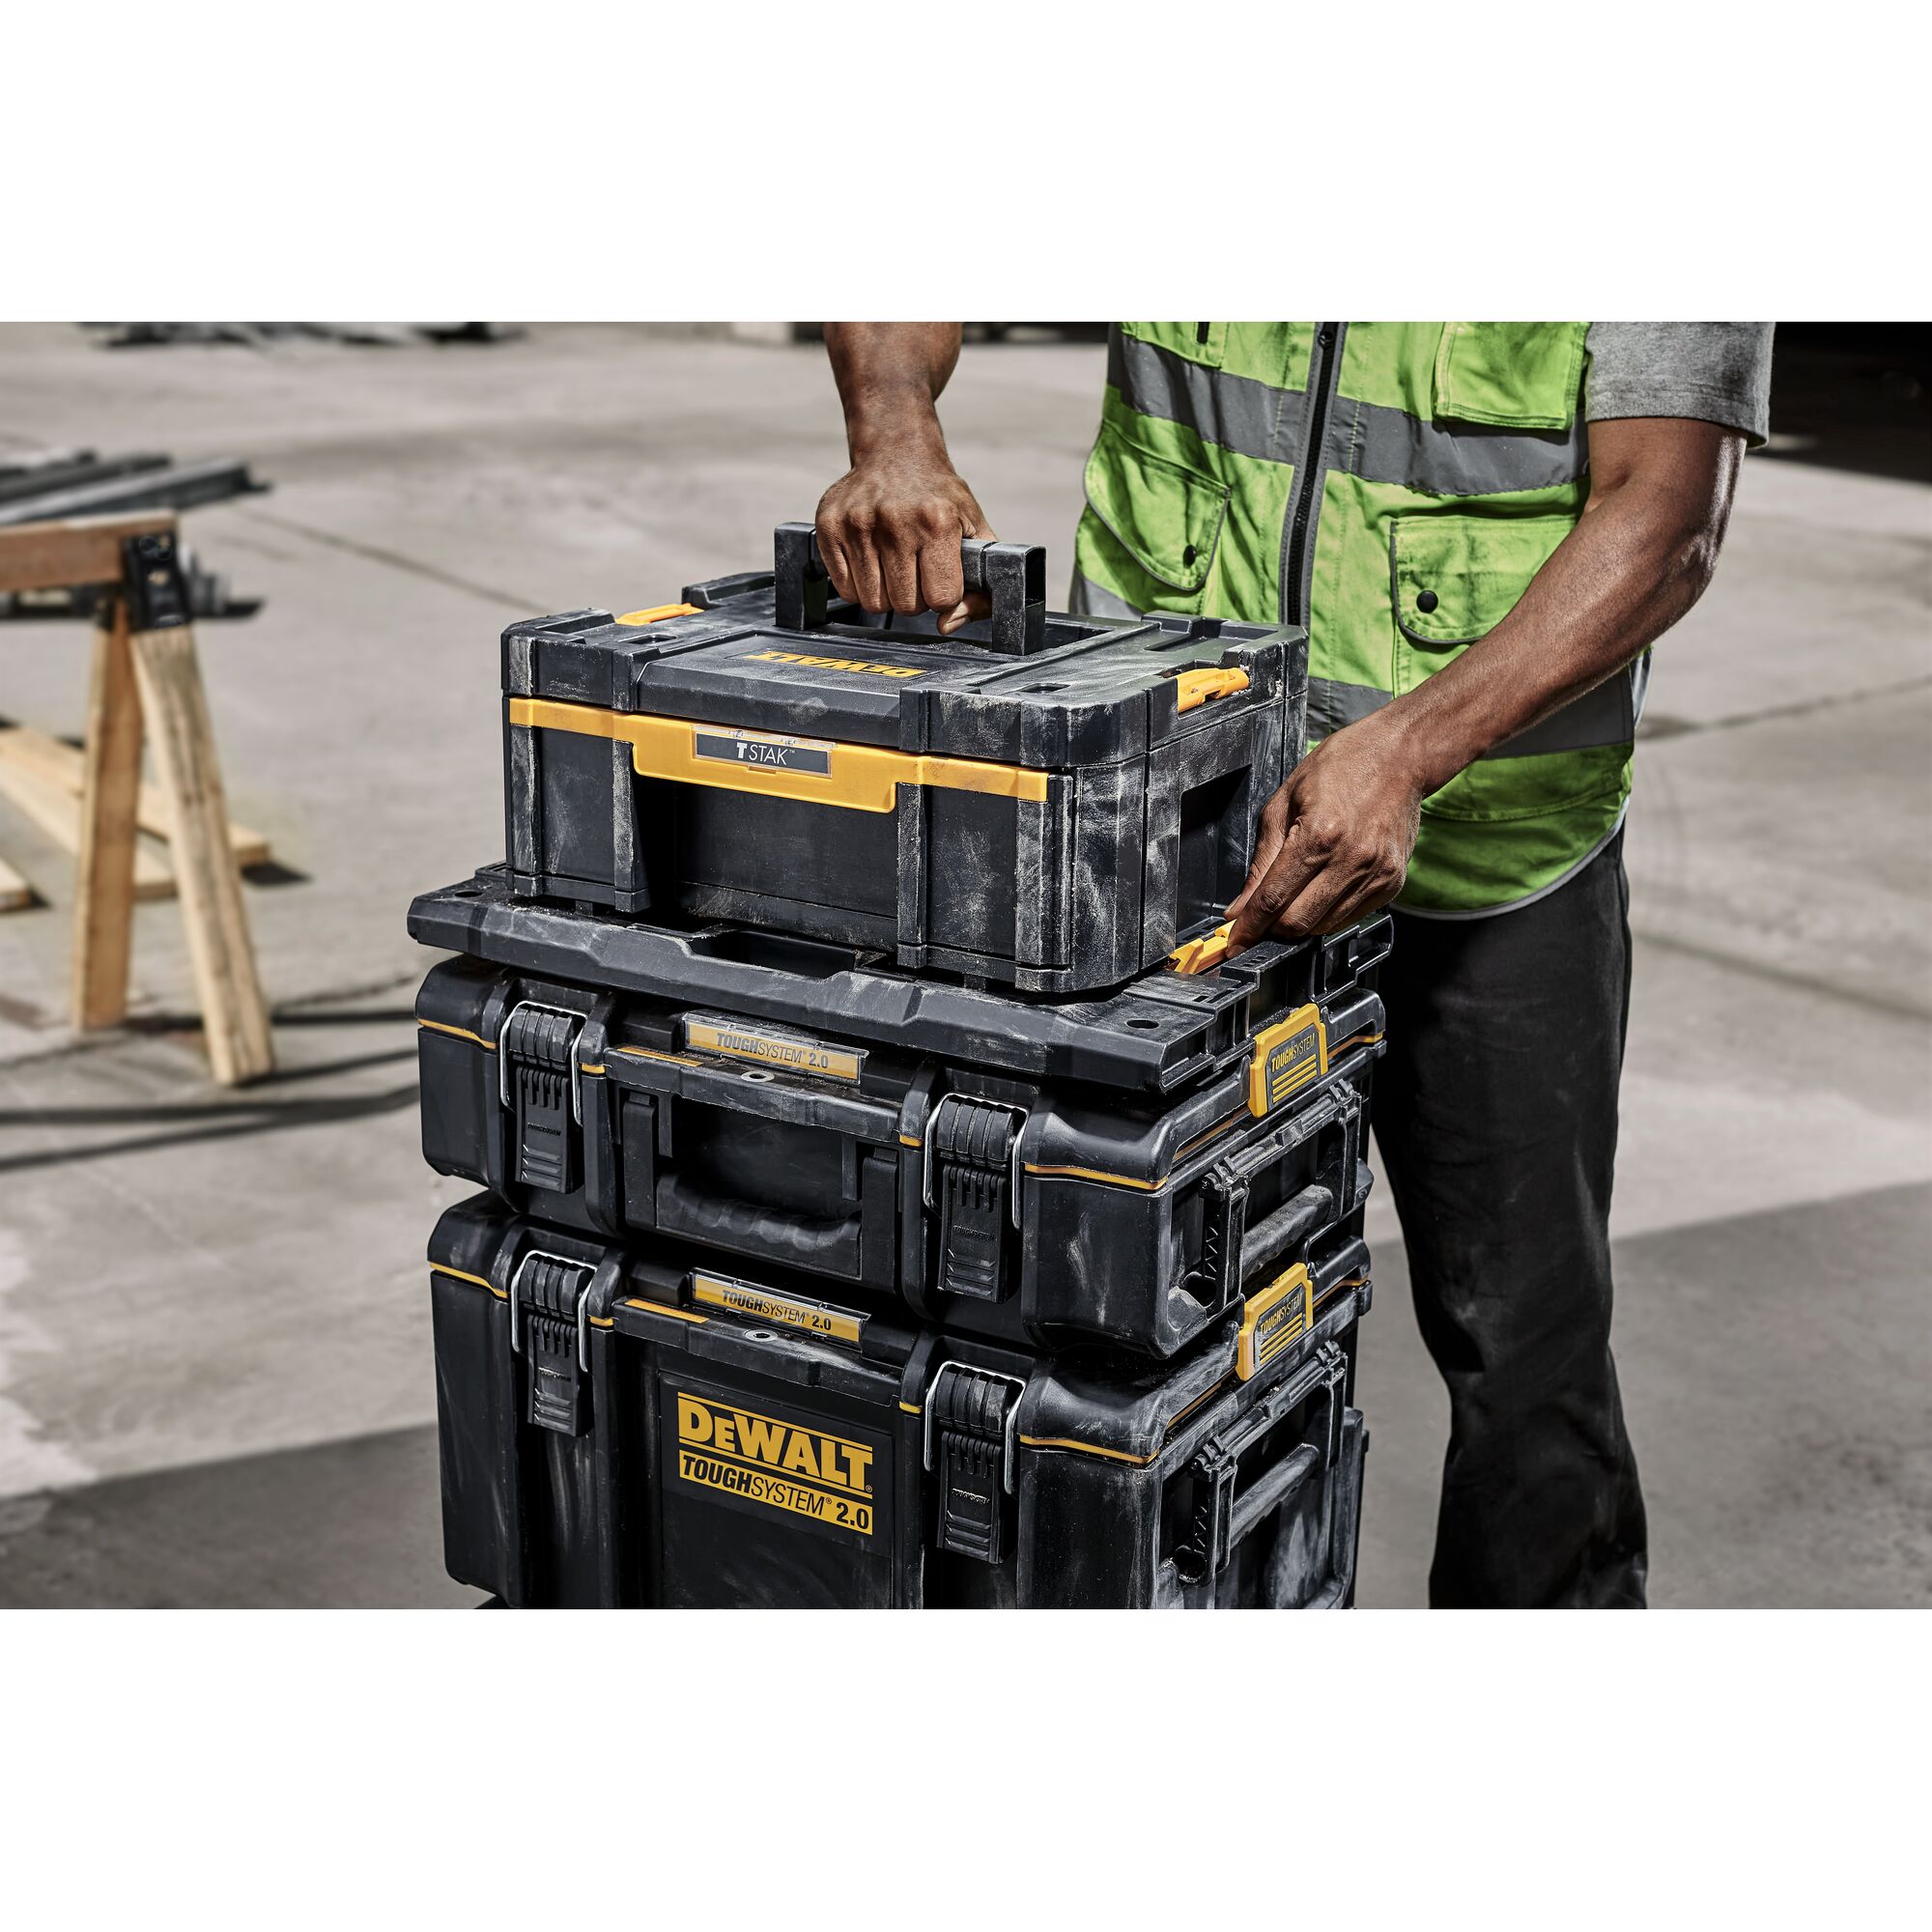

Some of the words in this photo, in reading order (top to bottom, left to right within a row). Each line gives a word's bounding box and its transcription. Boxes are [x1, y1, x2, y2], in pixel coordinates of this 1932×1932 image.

[809, 1052, 829, 1069] 2.0
[1271, 1032, 1316, 1073] TOUGHSYSTEM
[811, 1314, 832, 1331] 2.0
[1260, 1292, 1303, 1335] TOUGHSYSTEM
[836, 1502, 869, 1530] 2.0
